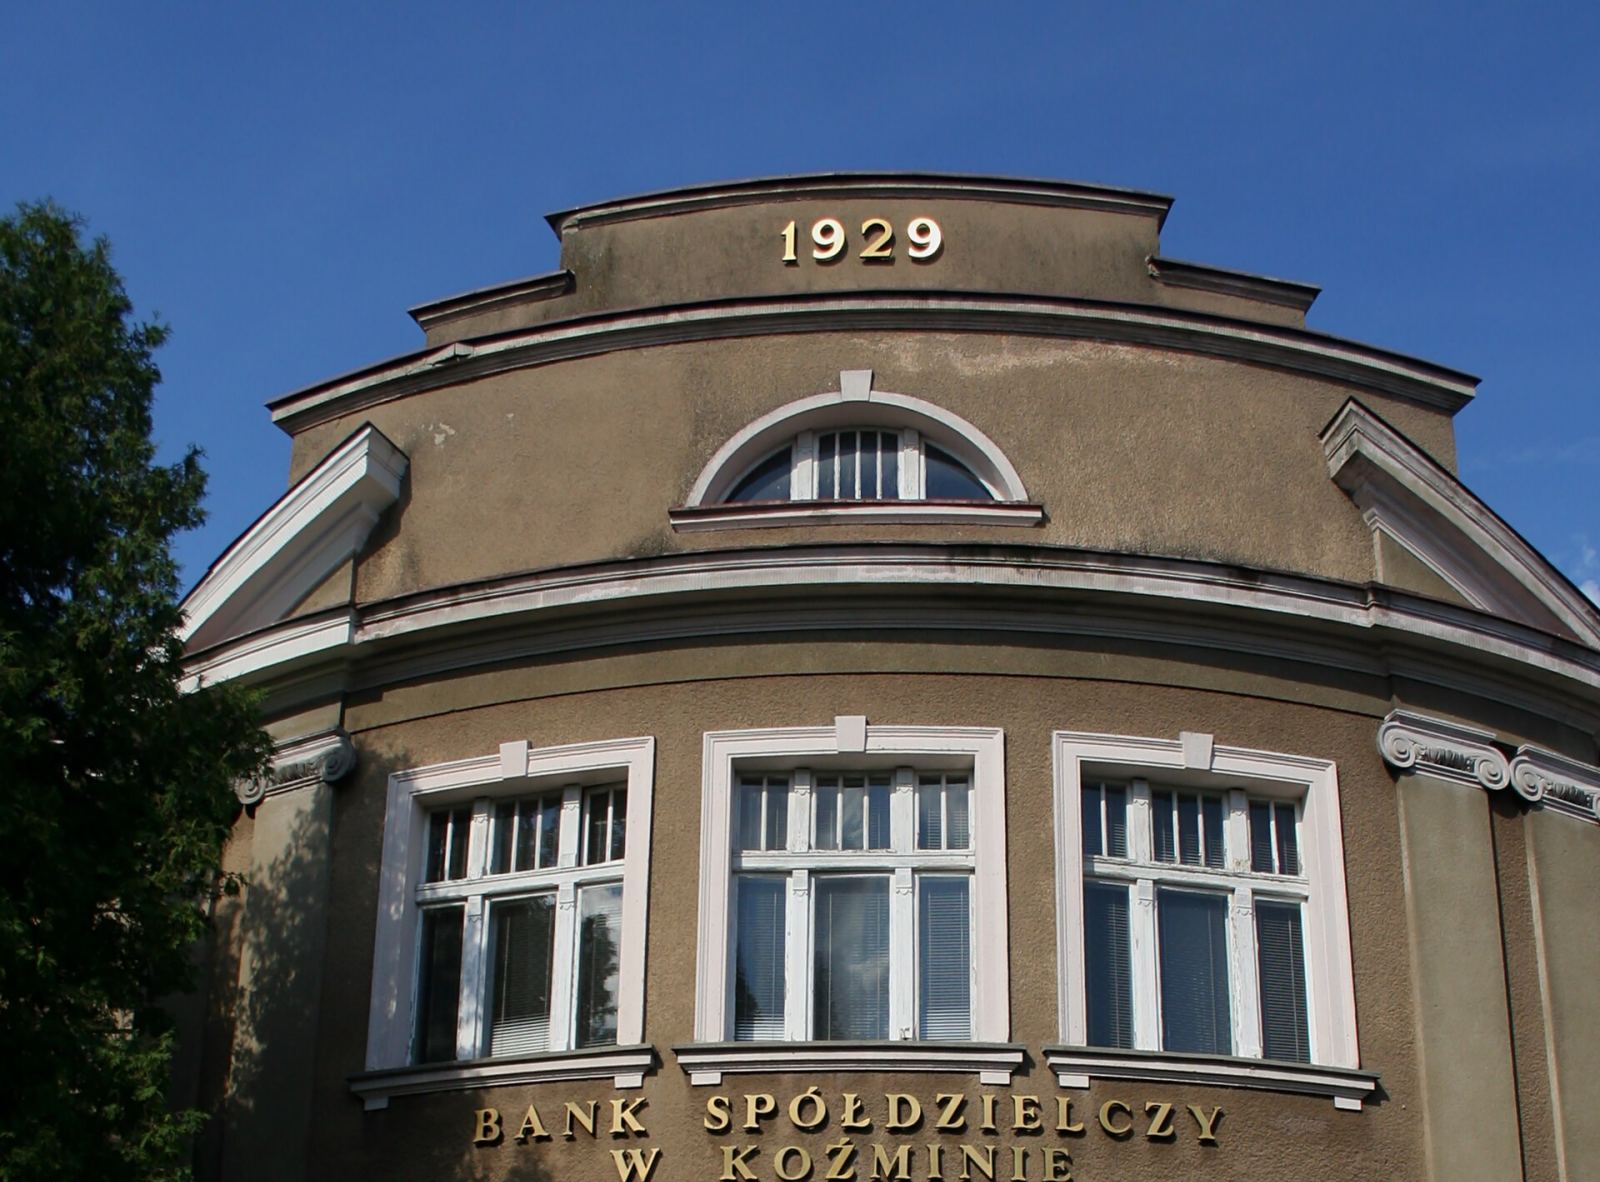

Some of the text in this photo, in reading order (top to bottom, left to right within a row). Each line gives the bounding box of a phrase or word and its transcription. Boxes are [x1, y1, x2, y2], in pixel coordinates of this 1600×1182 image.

[780, 217, 942, 262] 1929
[473, 1086, 1222, 1143] BANK SPÓŁDZIELCZY
[719, 1137, 1073, 1182] KOŹMINIE
